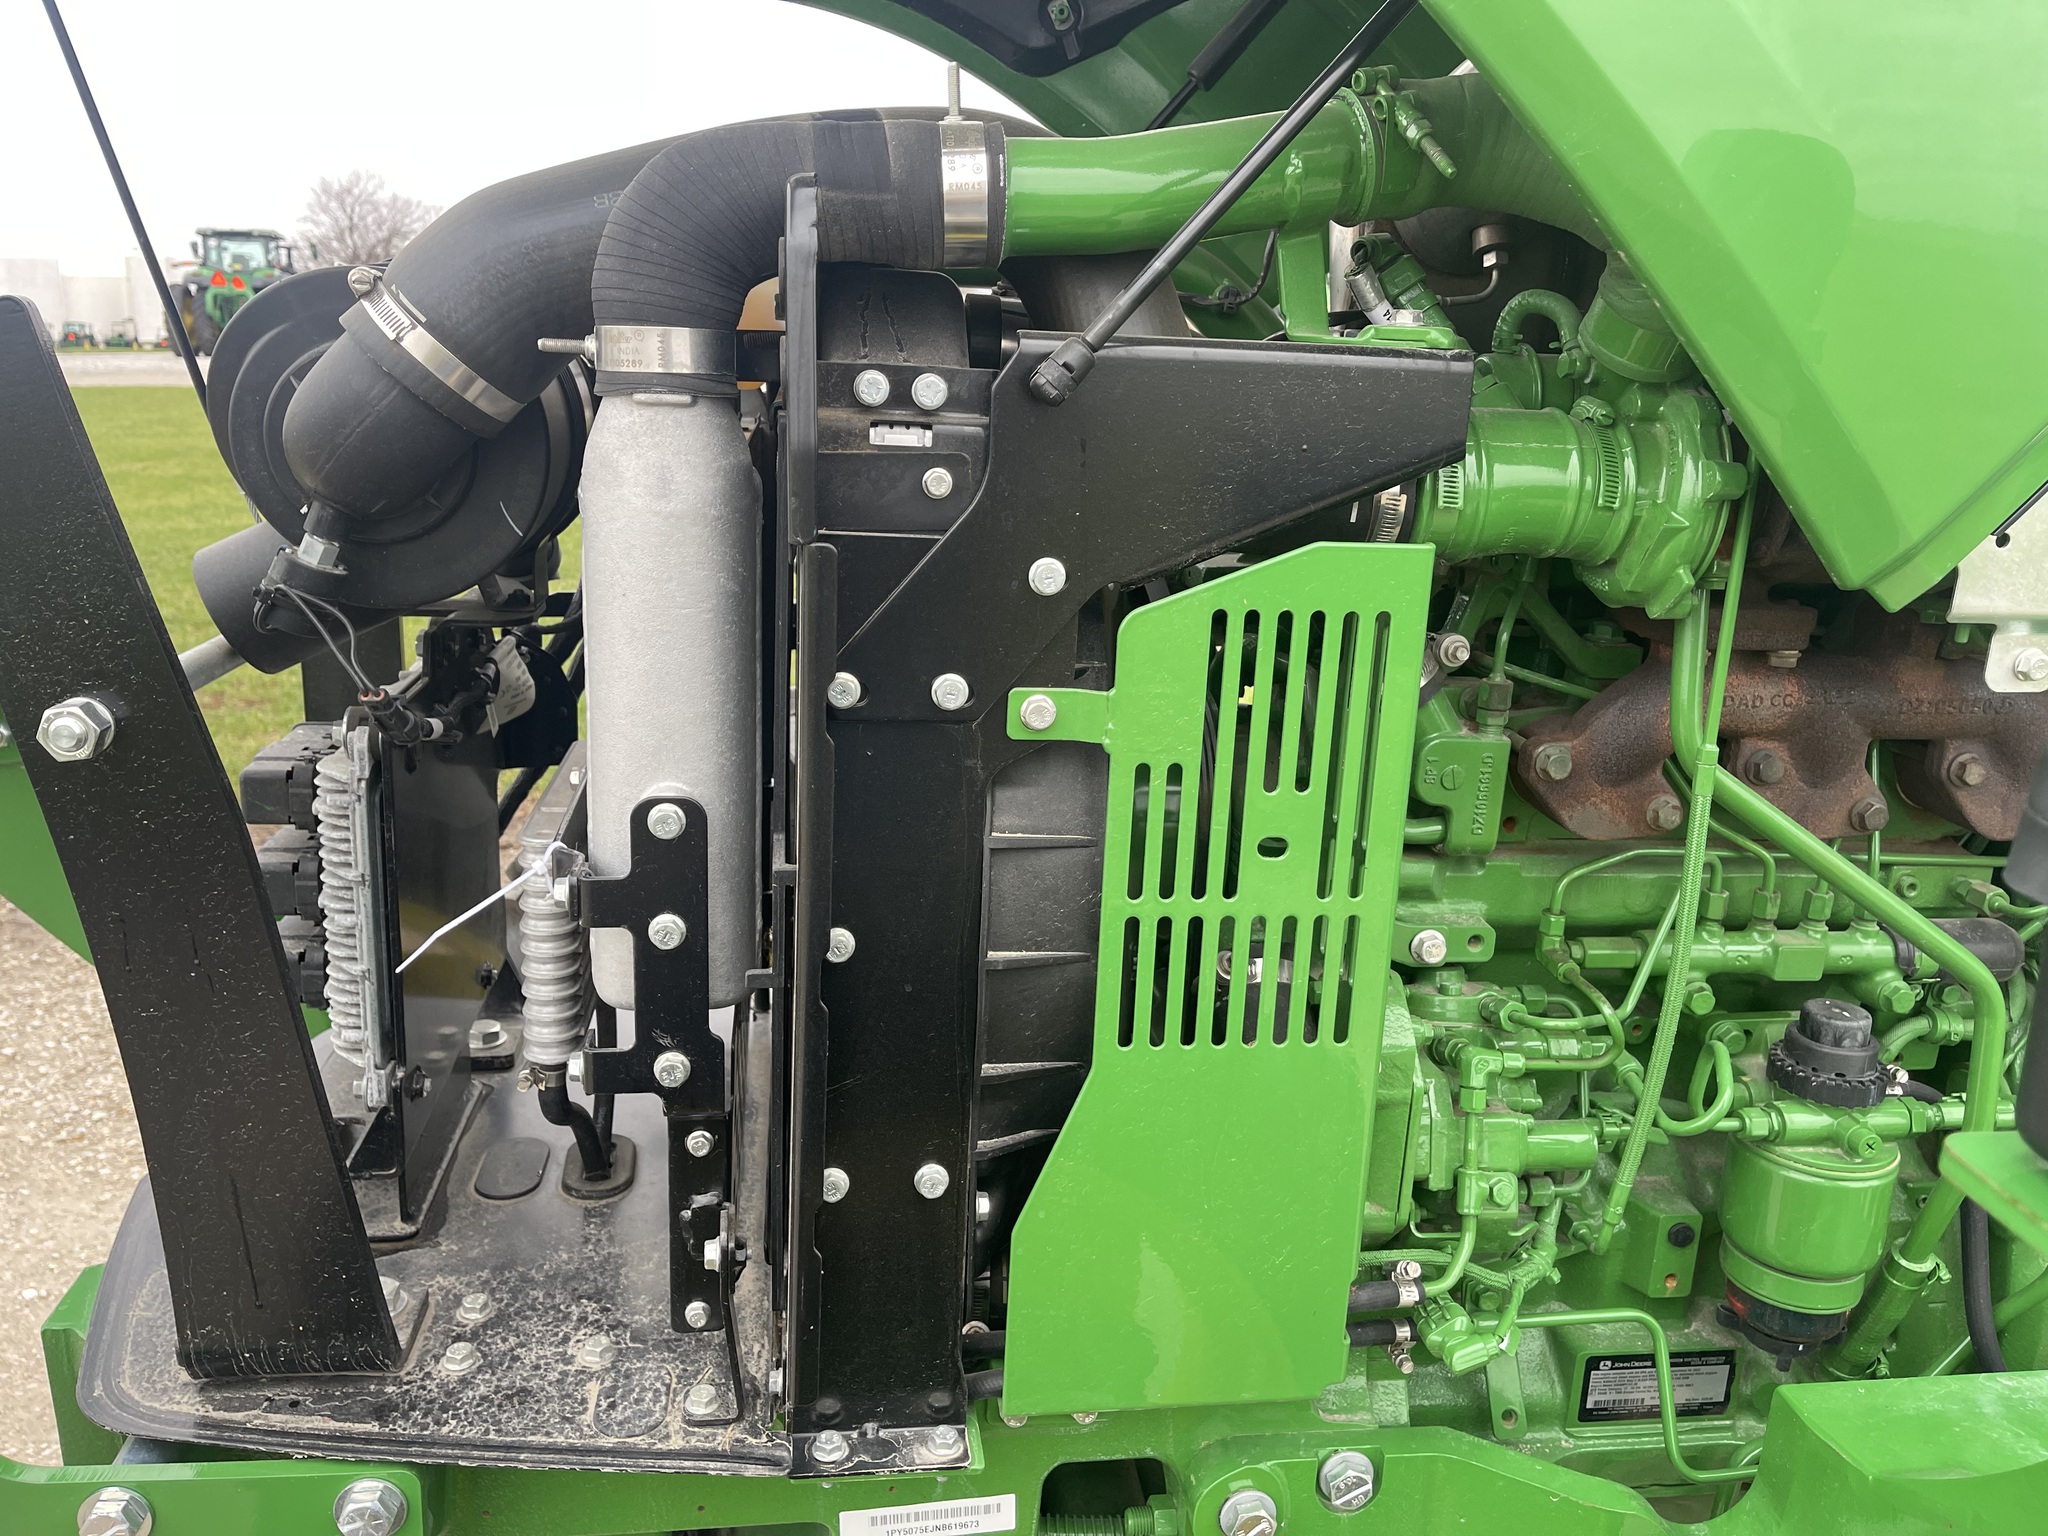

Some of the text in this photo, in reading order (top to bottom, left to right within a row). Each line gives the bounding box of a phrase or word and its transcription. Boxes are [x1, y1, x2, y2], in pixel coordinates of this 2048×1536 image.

[948, 182, 983, 191] RM045
[656, 332, 666, 368] RM045
[886, 1519, 980, 1536] 1PY5075EJNB619673
